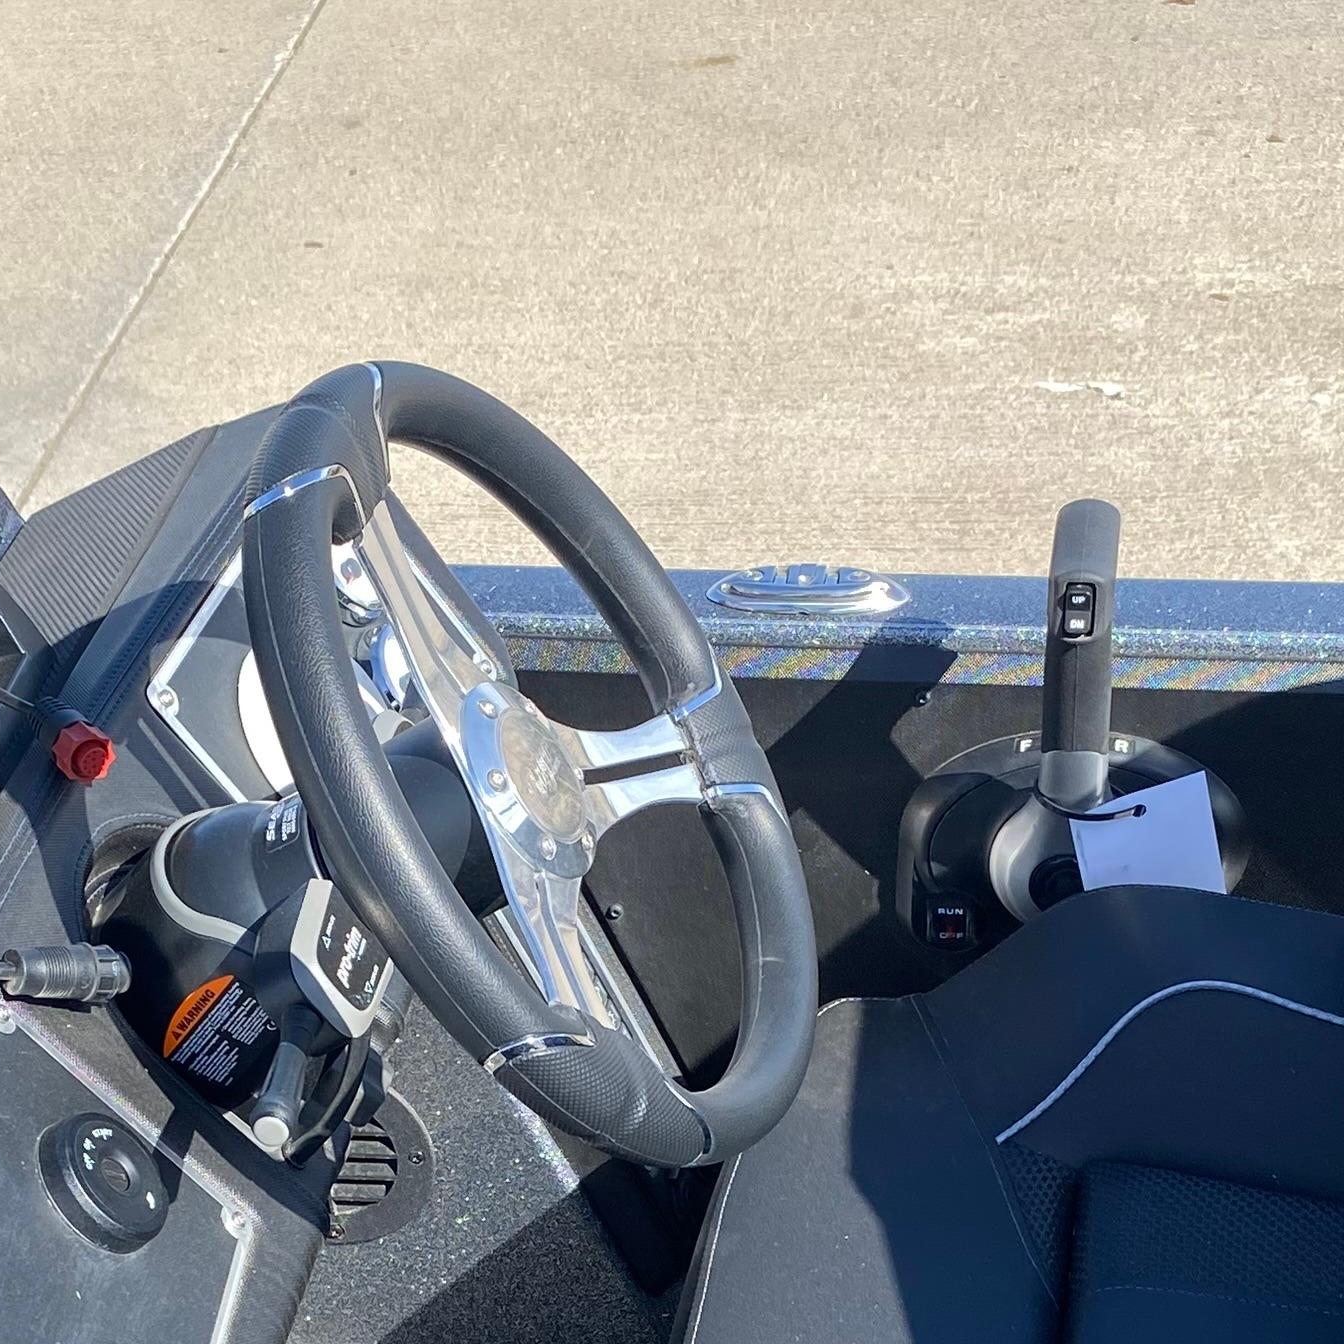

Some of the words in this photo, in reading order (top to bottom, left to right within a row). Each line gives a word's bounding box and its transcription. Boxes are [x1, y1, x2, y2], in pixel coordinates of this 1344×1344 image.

[1072, 596, 1086, 604] UP
[1070, 618, 1084, 629] DN
[1020, 739, 1032, 752] F
[1114, 739, 1128, 754] R
[336, 926, 362, 990] pro-trim
[176, 989, 216, 1032] WARNING
